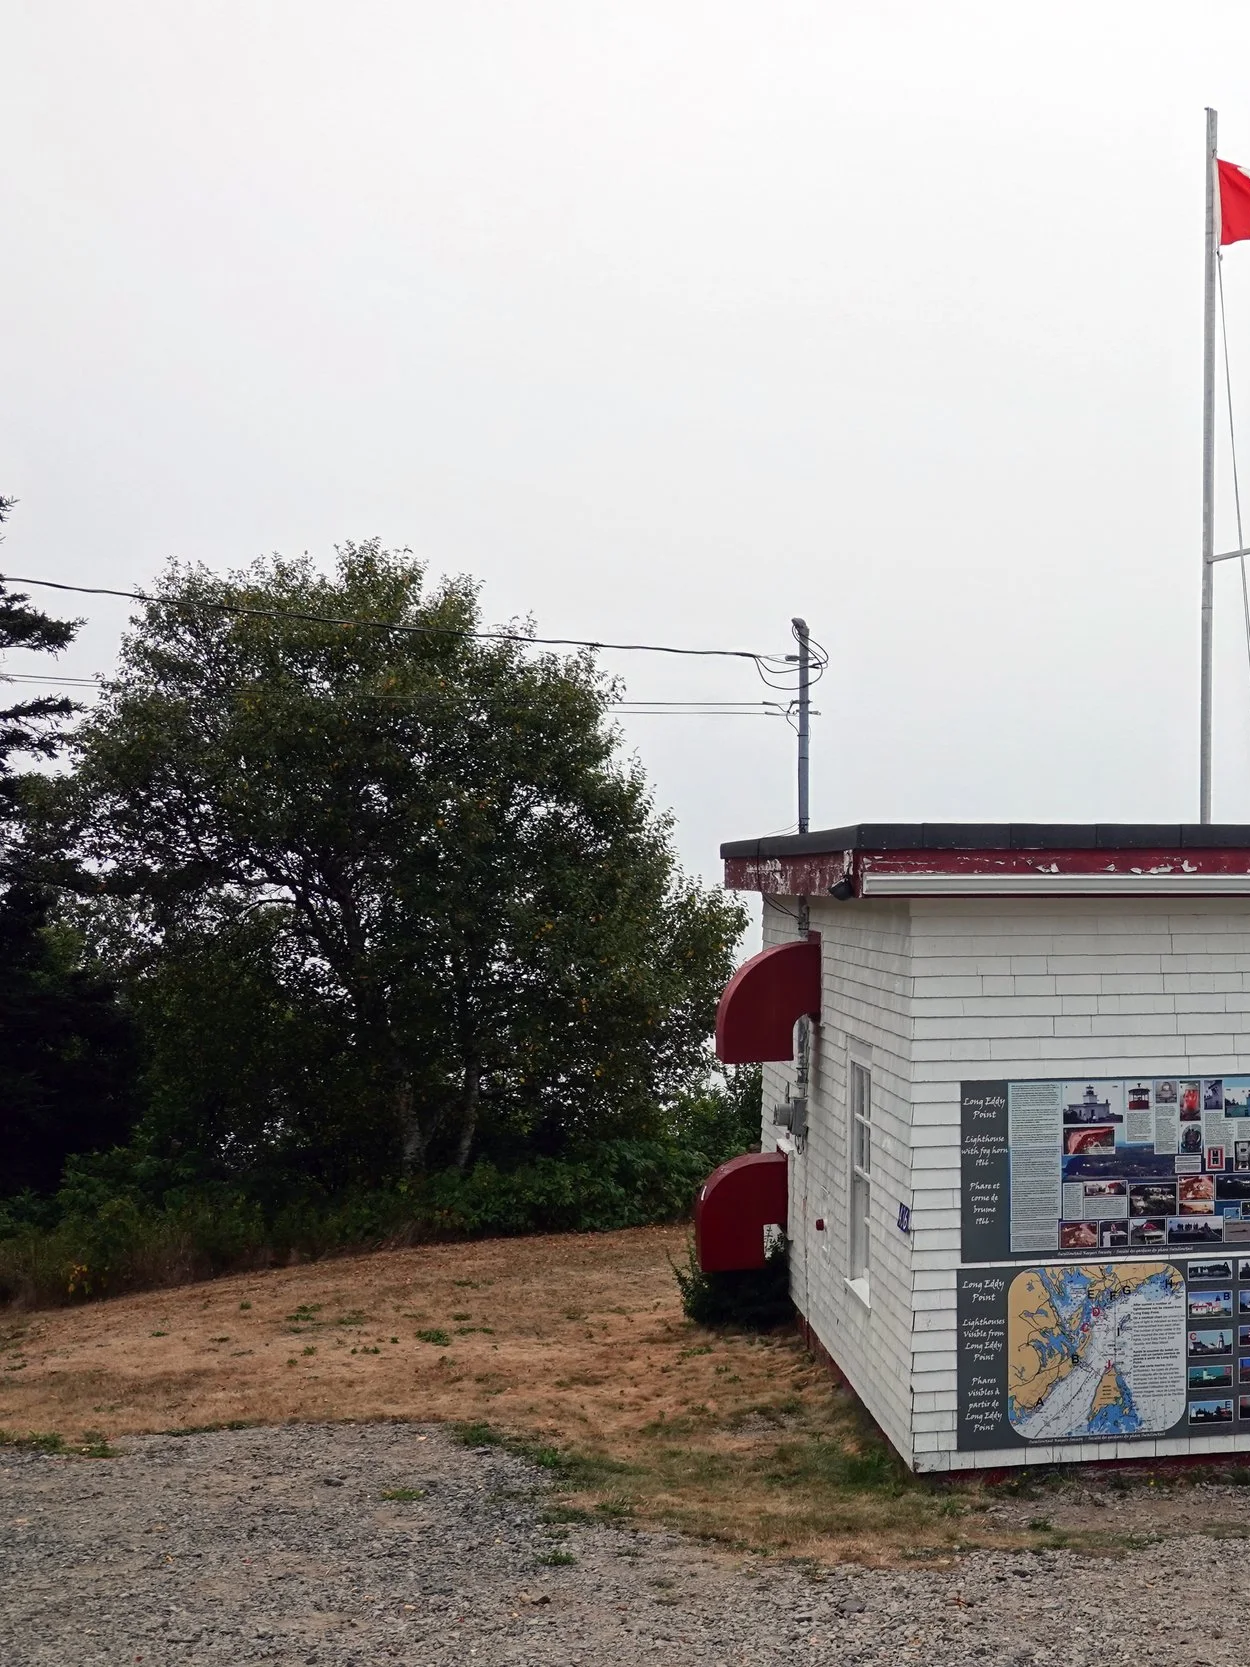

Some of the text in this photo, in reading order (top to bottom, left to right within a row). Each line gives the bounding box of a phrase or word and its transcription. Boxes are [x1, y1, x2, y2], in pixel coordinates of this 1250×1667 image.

[963, 1096, 1006, 1110] Long Eddy
[973, 1110, 996, 1120] Point
[964, 1134, 1005, 1147] Lighthouse
[962, 1146, 1008, 1158] with fog horn
[969, 1182, 992, 1191] Phare
[991, 1193, 998, 1203] de
[973, 1205, 996, 1214] brume
[962, 1279, 1005, 1293] Long Eddy
[1165, 1279, 1173, 1288] H
[1088, 1290, 1095, 1299] E
[1122, 1285, 1131, 1295] G
[972, 1293, 996, 1303] Point
[1110, 1291, 1117, 1300] F
[1223, 1292, 1230, 1300] B
[962, 1318, 1005, 1330] Lighthouses
[963, 1329, 1004, 1341] Visible from
[1190, 1333, 1197, 1341] C
[965, 1341, 1003, 1354] Long Eddy
[974, 1353, 994, 1362] Point
[1072, 1355, 1079, 1364] B
[971, 1376, 996, 1386] Phares
[968, 1388, 994, 1397] visibles
[968, 1400, 1000, 1413] partir de
[1035, 1397, 1044, 1407] A
[965, 1411, 1003, 1424] Long Eddy
[973, 1423, 995, 1432] Point
